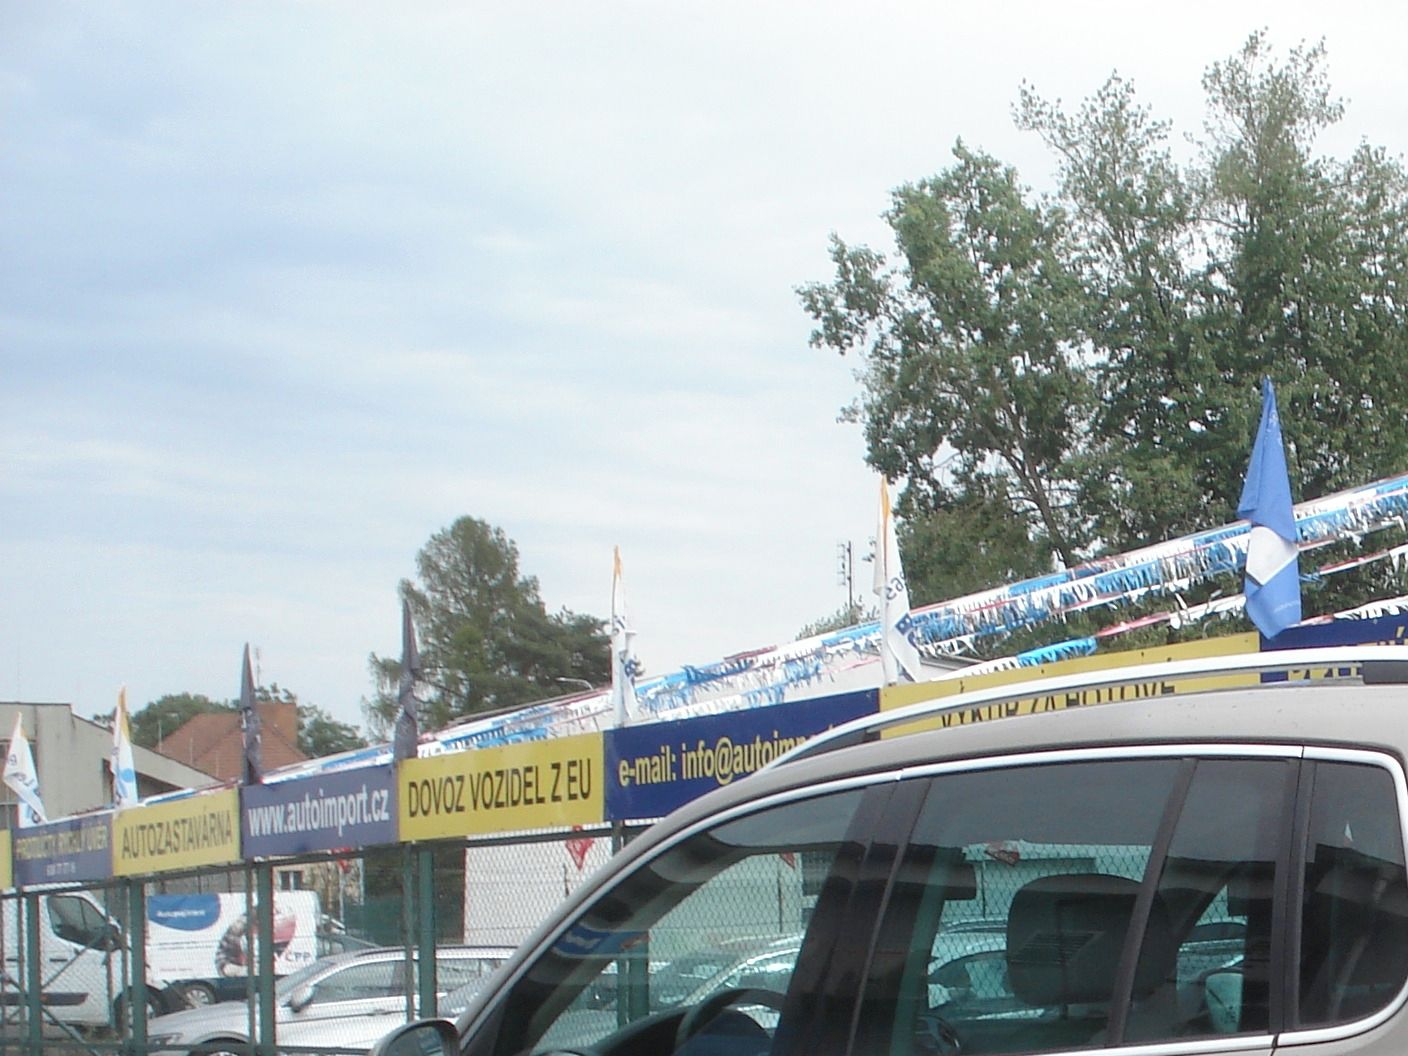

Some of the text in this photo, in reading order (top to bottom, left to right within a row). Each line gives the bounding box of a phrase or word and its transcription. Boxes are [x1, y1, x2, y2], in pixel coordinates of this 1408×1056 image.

[408, 757, 593, 818] DOVOZ VOZIDEL Z EU
[618, 743, 677, 787] e-mail:
[248, 783, 391, 838] www.autoimport.cz
